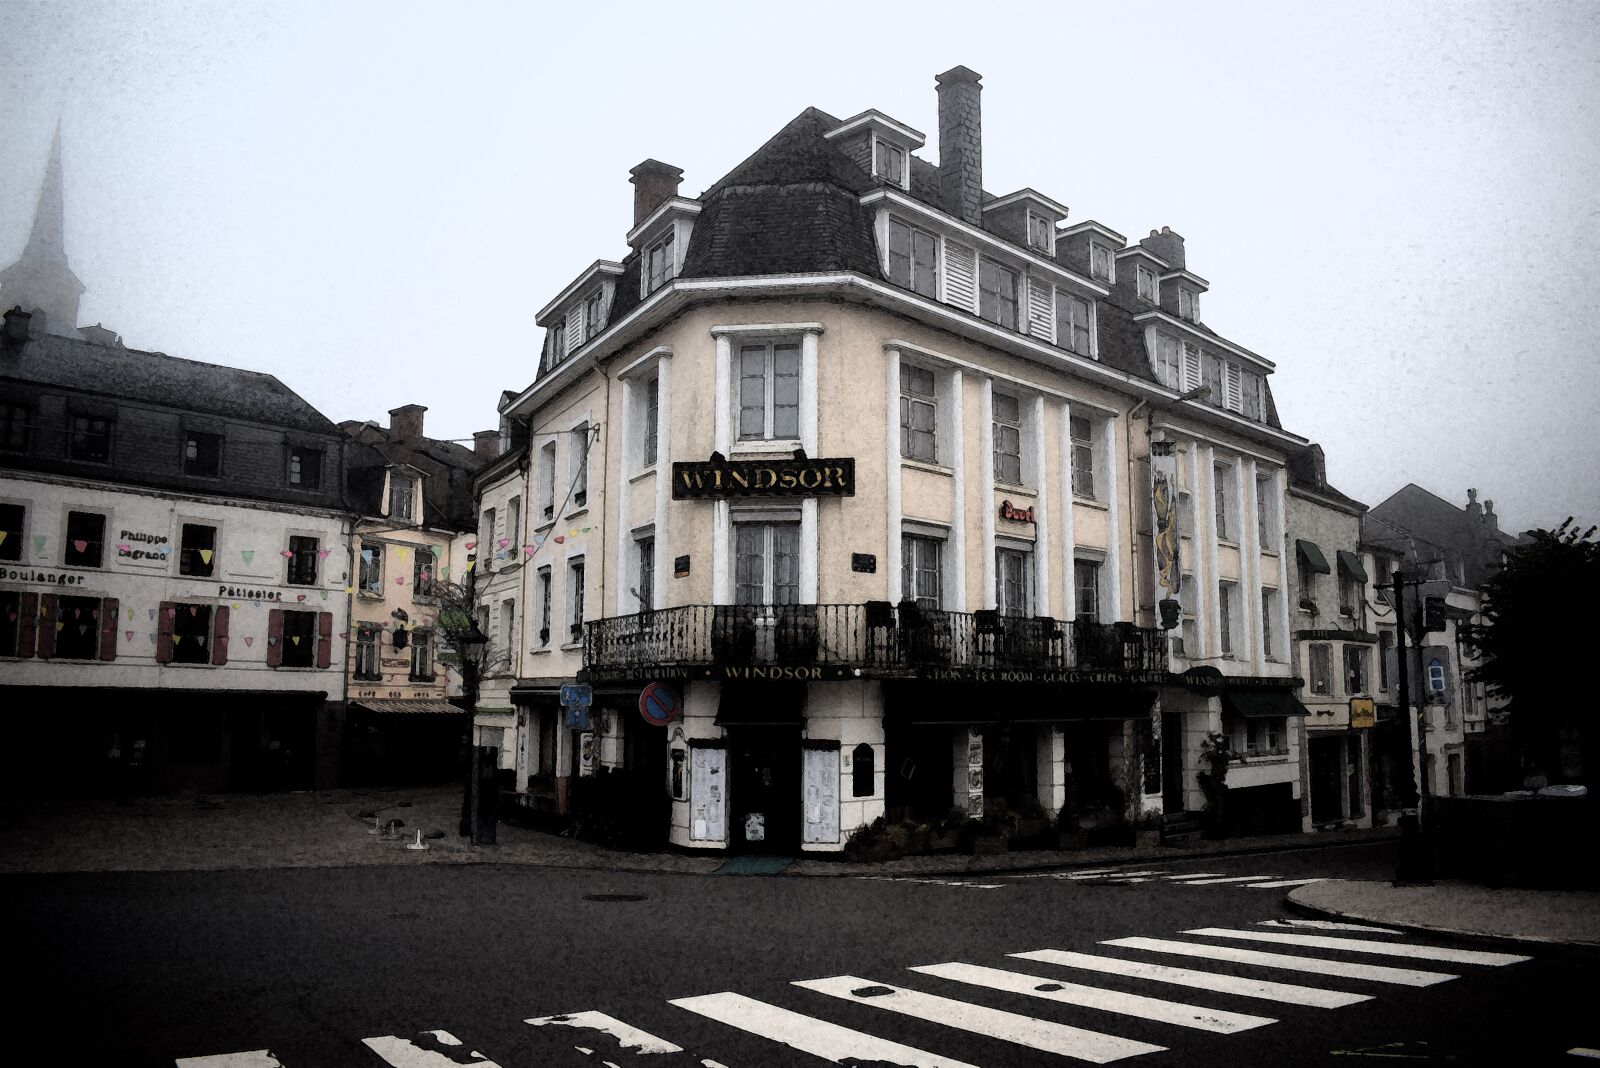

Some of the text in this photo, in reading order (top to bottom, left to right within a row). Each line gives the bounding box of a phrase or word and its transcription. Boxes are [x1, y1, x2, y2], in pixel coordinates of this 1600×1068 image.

[681, 466, 847, 489] WINDSOR
[120, 530, 168, 544] Philippe
[0, 567, 85, 585] Boulanger
[724, 665, 823, 680] WINDSOR
